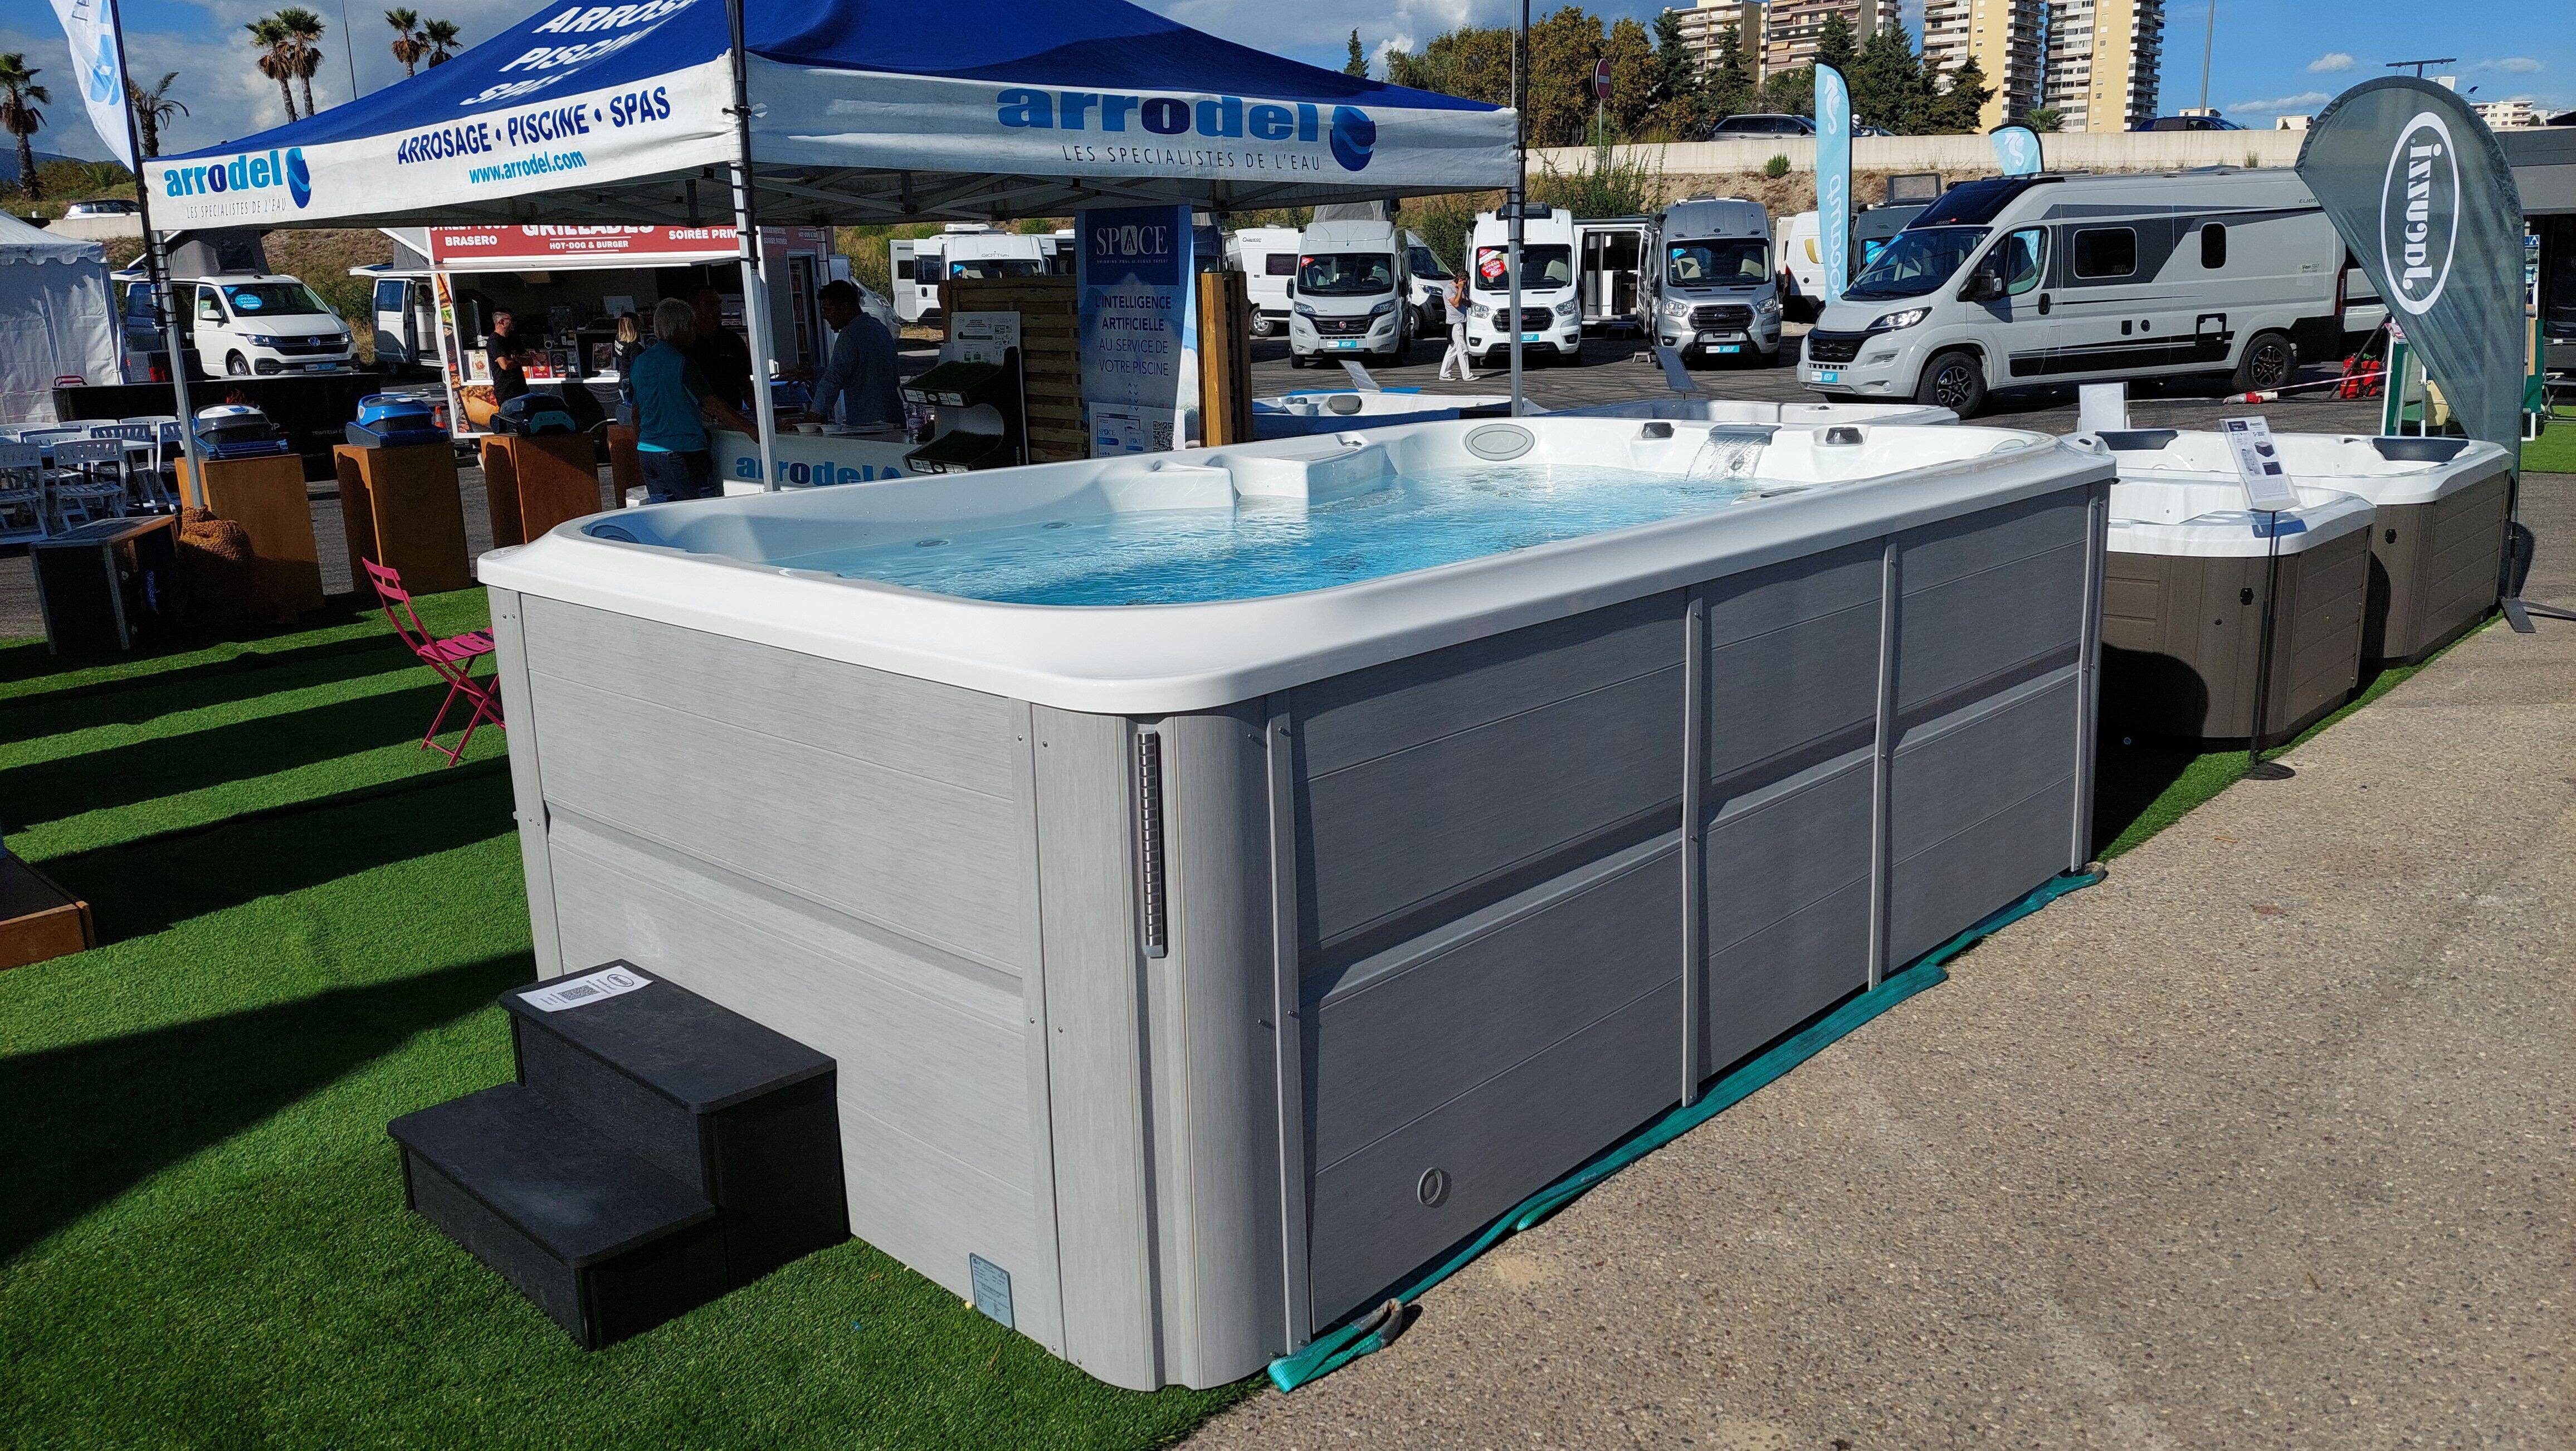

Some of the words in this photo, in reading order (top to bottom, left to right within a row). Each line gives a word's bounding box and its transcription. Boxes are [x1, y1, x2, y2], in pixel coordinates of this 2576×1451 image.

[997, 88, 1318, 142] arrodel
[397, 122, 492, 165] ARROSAGE
[508, 103, 589, 147] PISCINE
[609, 86, 671, 128] SPAS
[469, 149, 587, 184] www.arrodel.com
[1062, 145, 1096, 162] LES
[1107, 147, 1235, 168] SPECIALISTES
[1246, 153, 1265, 169] DE
[1275, 154, 1320, 171] L'EAU
[164, 150, 283, 197] arrodel
[187, 206, 198, 219] LES
[201, 202, 248, 218] SPECIALISTES
[252, 200, 261, 213] DE
[265, 198, 286, 212] L'EAU
[445, 235, 497, 246] BRASERO
[669, 228, 709, 240] SOIRÉE
[711, 229, 739, 239] PRIV
[1096, 225, 1168, 256] SPACE
[549, 242, 586, 250] HOT-DOG
[597, 240, 629, 249] BURGER
[1095, 295, 1172, 310] L'INTELLIGENCE
[1102, 317, 1164, 331] ARTIFICIELLE
[1099, 338, 1113, 351] AU
[1116, 338, 1154, 353] SERVICE
[1155, 340, 1168, 354] DE
[1099, 358, 1130, 374] VOTRE
[1133, 361, 1169, 376] PISCINE
